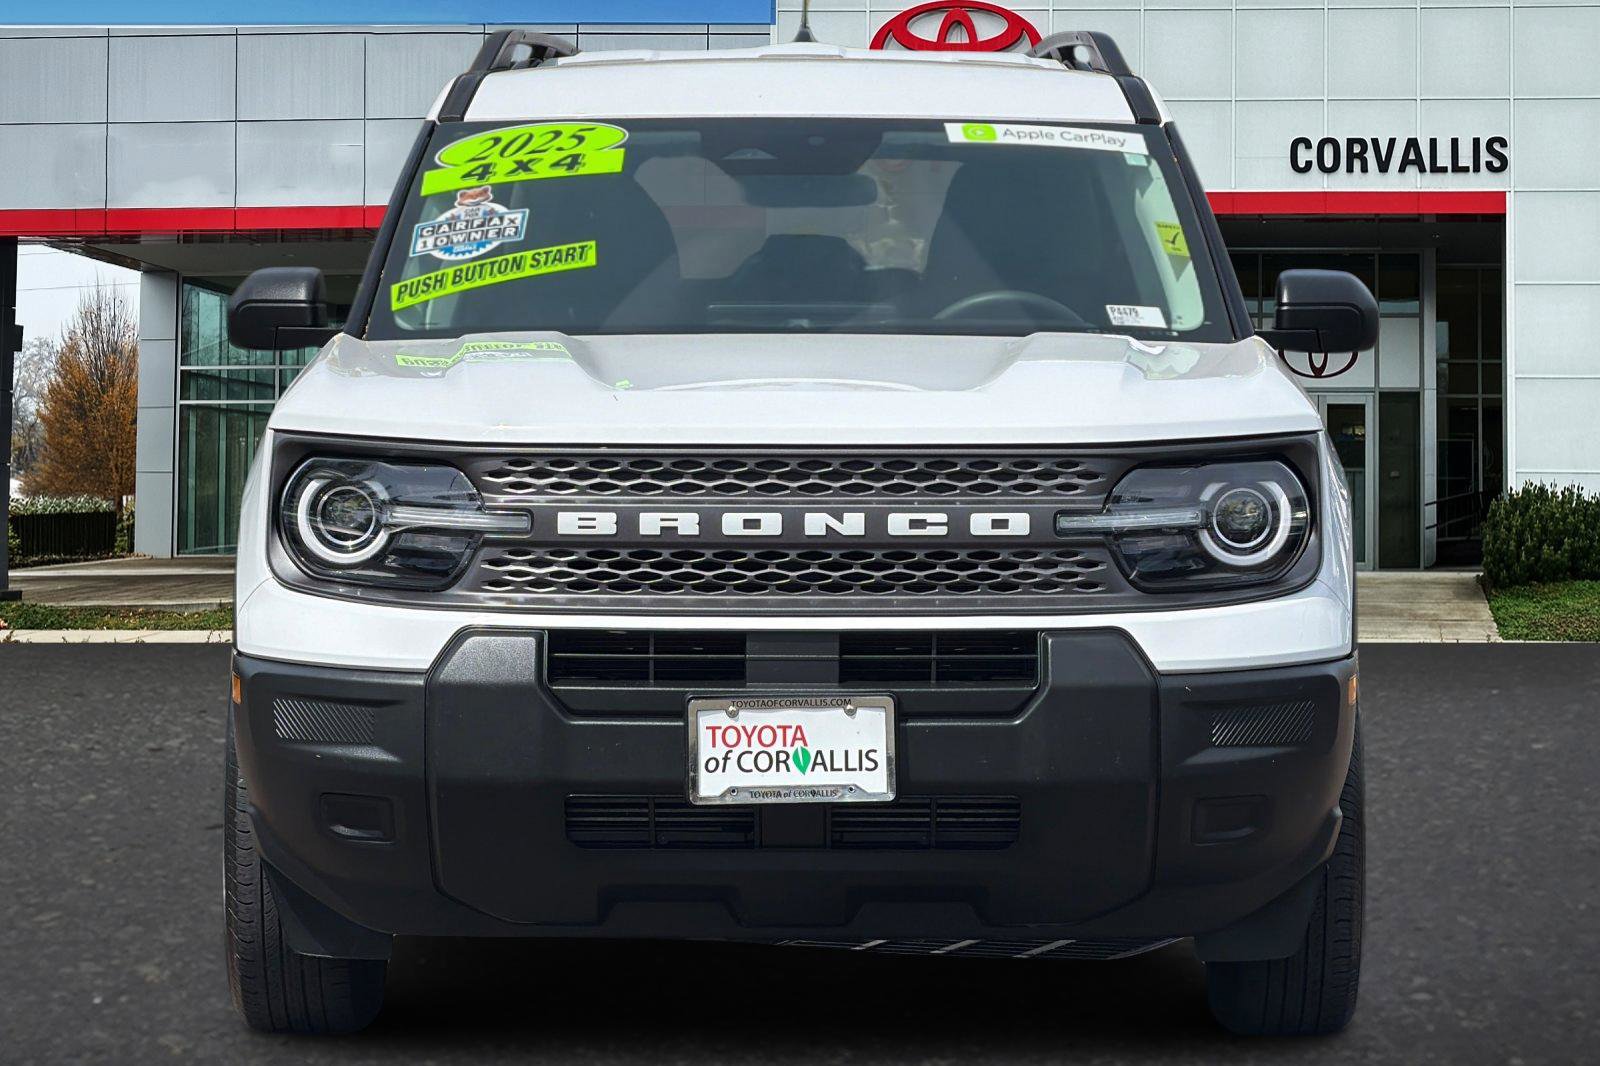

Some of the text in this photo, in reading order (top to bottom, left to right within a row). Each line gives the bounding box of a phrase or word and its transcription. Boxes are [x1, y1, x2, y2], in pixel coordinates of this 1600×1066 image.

[464, 127, 597, 163] 2025
[1003, 128, 1126, 147] Apple CarPlay
[1290, 136, 1509, 173] CORVALLIS
[421, 216, 518, 237] CARFAX
[435, 228, 516, 247] OWNER
[396, 245, 590, 303] PUSH BUTTON START
[557, 512, 1031, 535] BRONCO
[731, 698, 852, 708] TOYOTAOFCORVALLIS.COM
[706, 725, 808, 748] TOYOTA
[704, 750, 731, 773] of
[750, 790, 783, 798] TOYOTA
